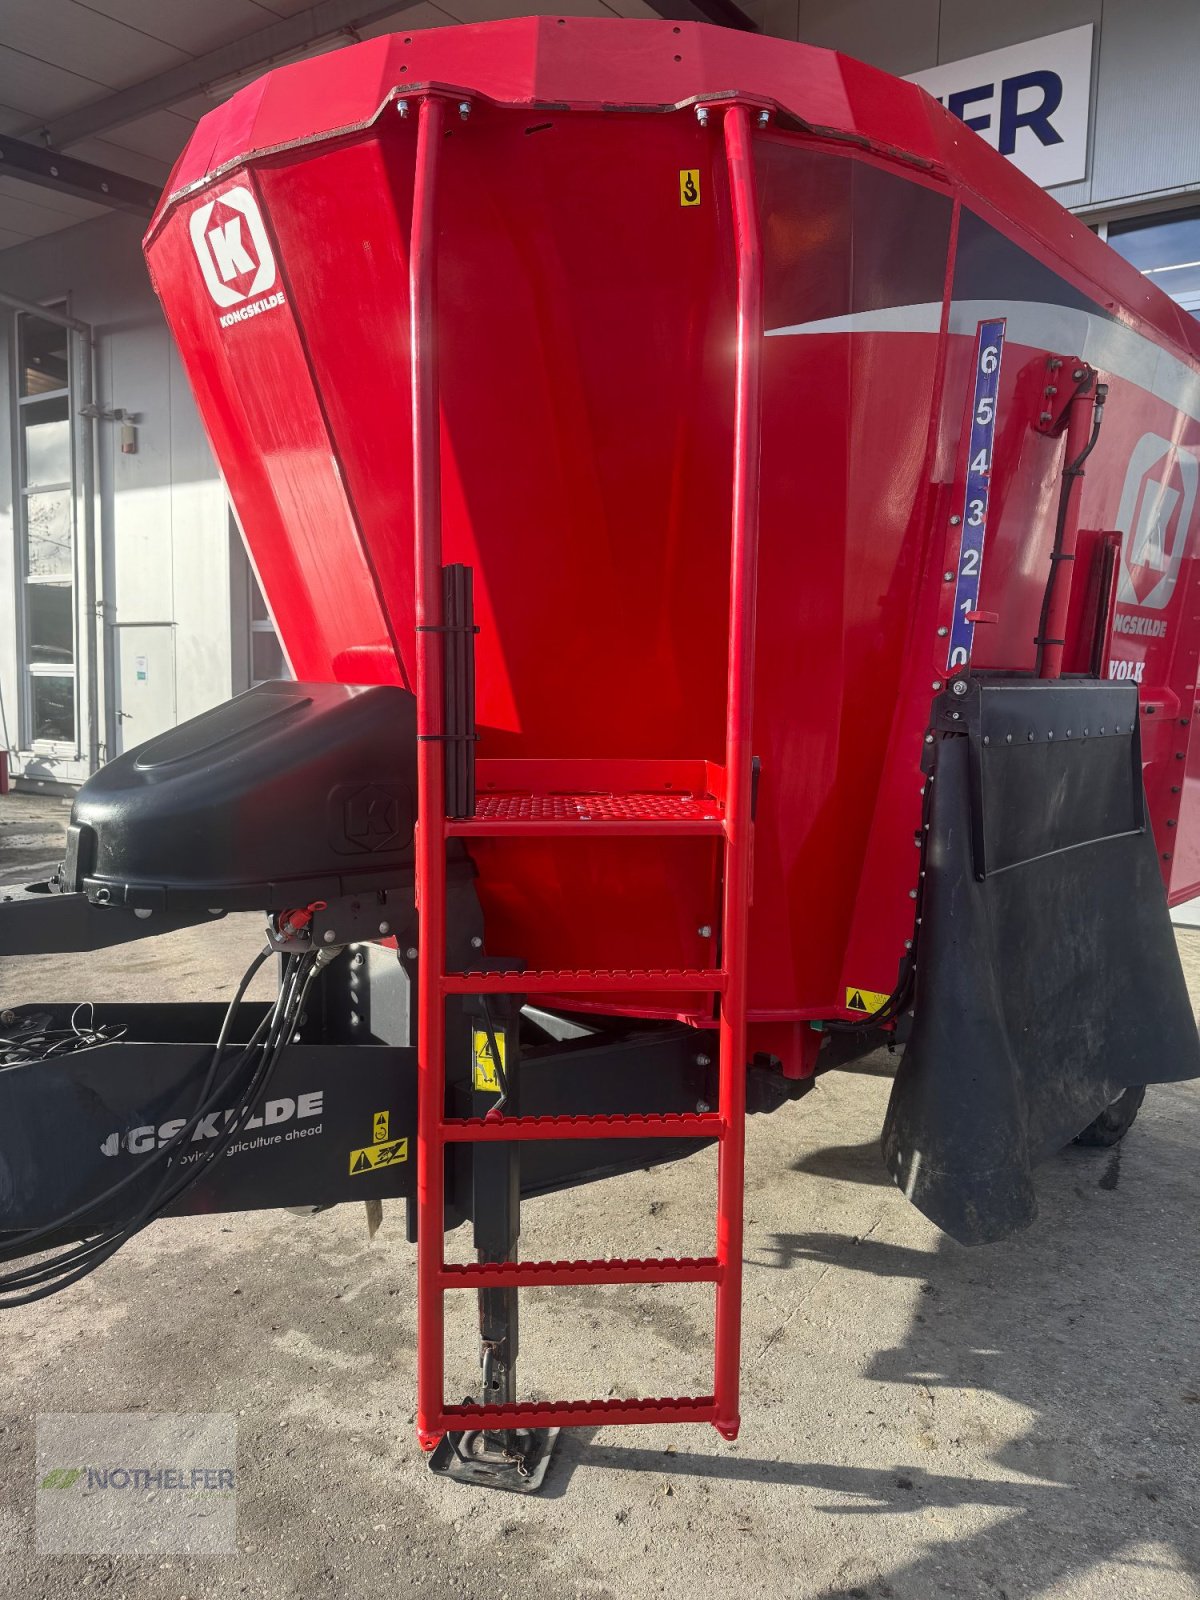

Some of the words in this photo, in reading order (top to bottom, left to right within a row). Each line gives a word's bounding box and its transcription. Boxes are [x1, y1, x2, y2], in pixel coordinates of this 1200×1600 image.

[208, 216, 257, 282] K
[219, 292, 286, 329] KONGSKILDE
[980, 346, 998, 374] 6
[976, 397, 994, 425] 5
[970, 449, 988, 475] 4
[967, 499, 985, 526] 3
[961, 549, 979, 575] 2
[960, 599, 973, 625] 1
[951, 646, 968, 668] 0
[1109, 660, 1146, 684] VOLK
[226, 1131, 282, 1157] griculture
[285, 1124, 323, 1141] ahead
